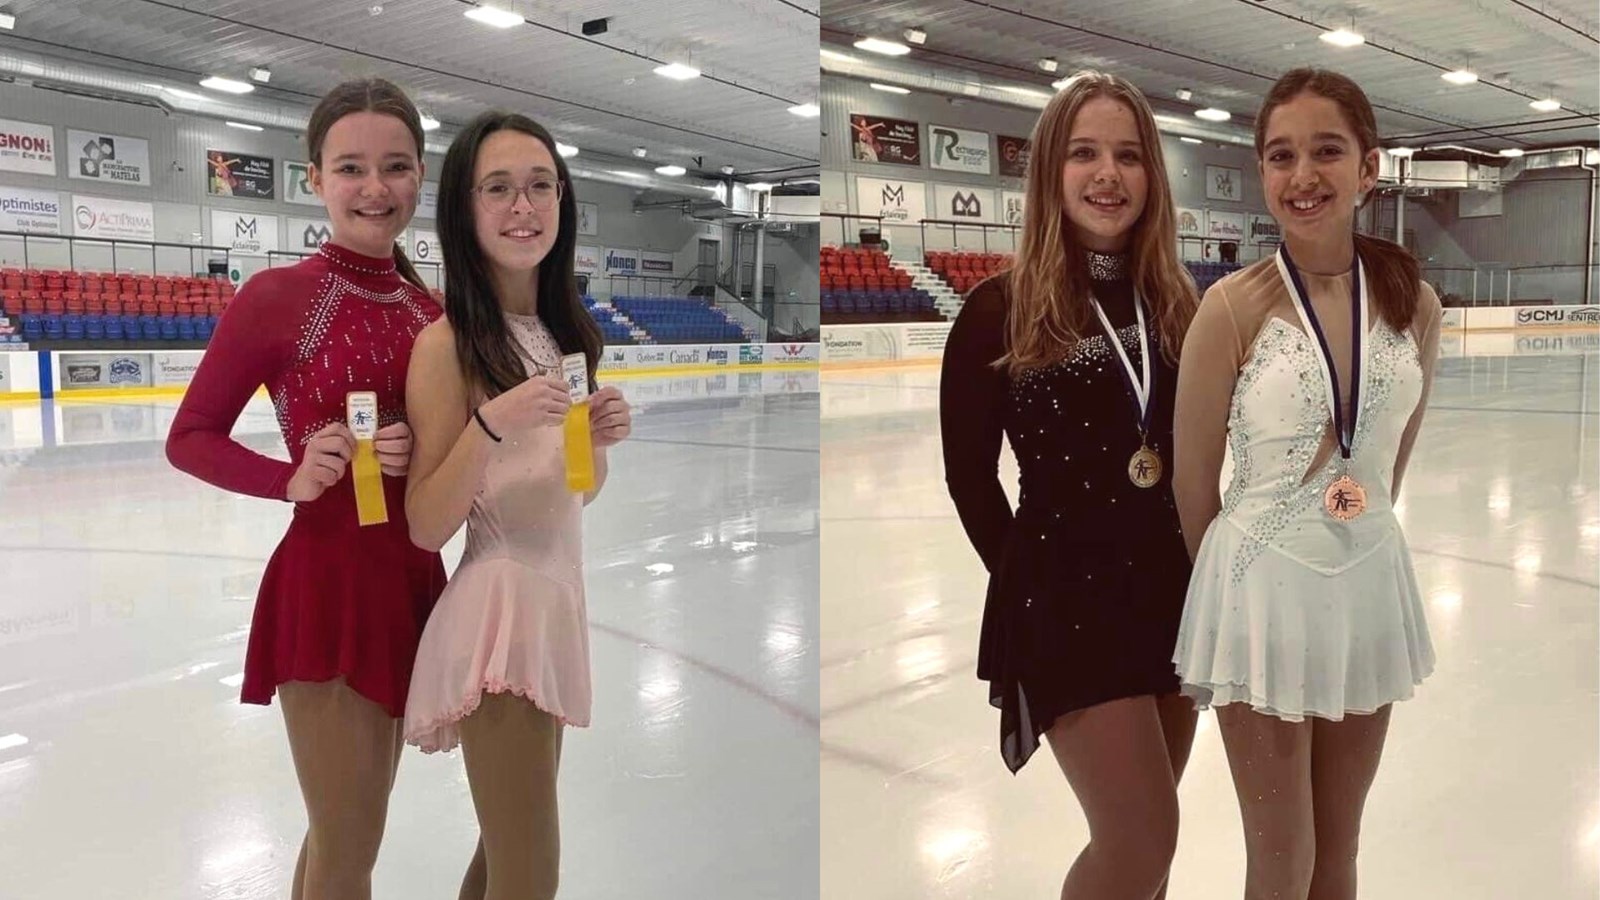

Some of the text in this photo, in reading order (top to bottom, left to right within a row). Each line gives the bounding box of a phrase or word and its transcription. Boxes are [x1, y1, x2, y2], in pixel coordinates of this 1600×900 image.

[111, 171, 140, 182] MATELAS
[0, 197, 57, 213] ptimistes
[1533, 310, 1564, 321] CMJ
[670, 350, 699, 364] Canada
